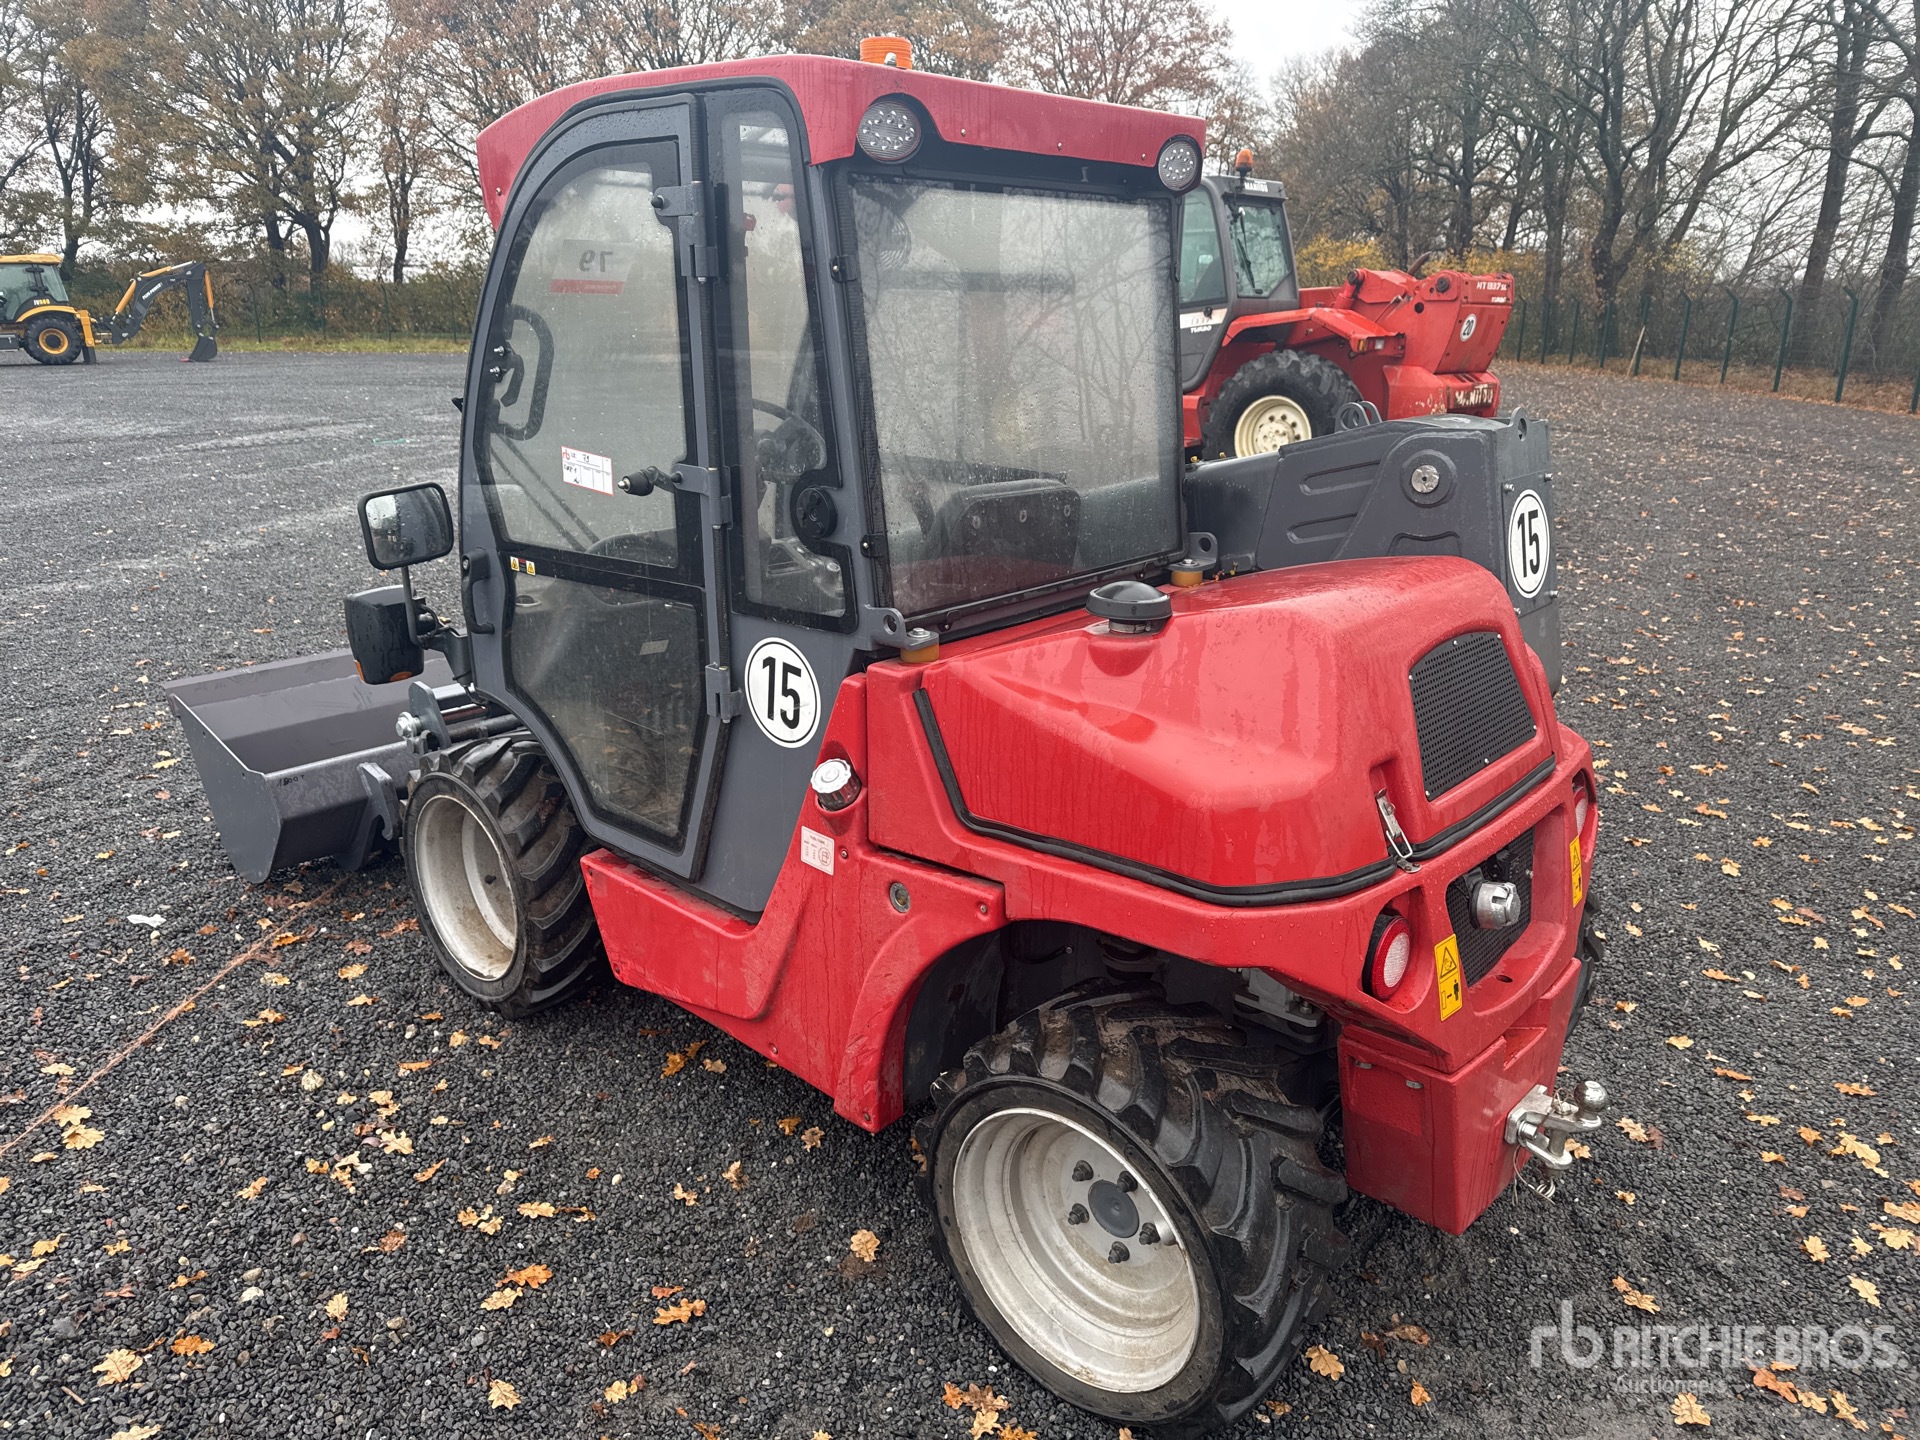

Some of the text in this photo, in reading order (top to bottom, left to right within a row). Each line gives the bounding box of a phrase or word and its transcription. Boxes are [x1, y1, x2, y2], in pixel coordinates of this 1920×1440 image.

[1190, 325, 1212, 333] TURBO
[1462, 319, 1475, 336] 20
[1517, 509, 1539, 578] 15
[762, 656, 801, 729] 15
